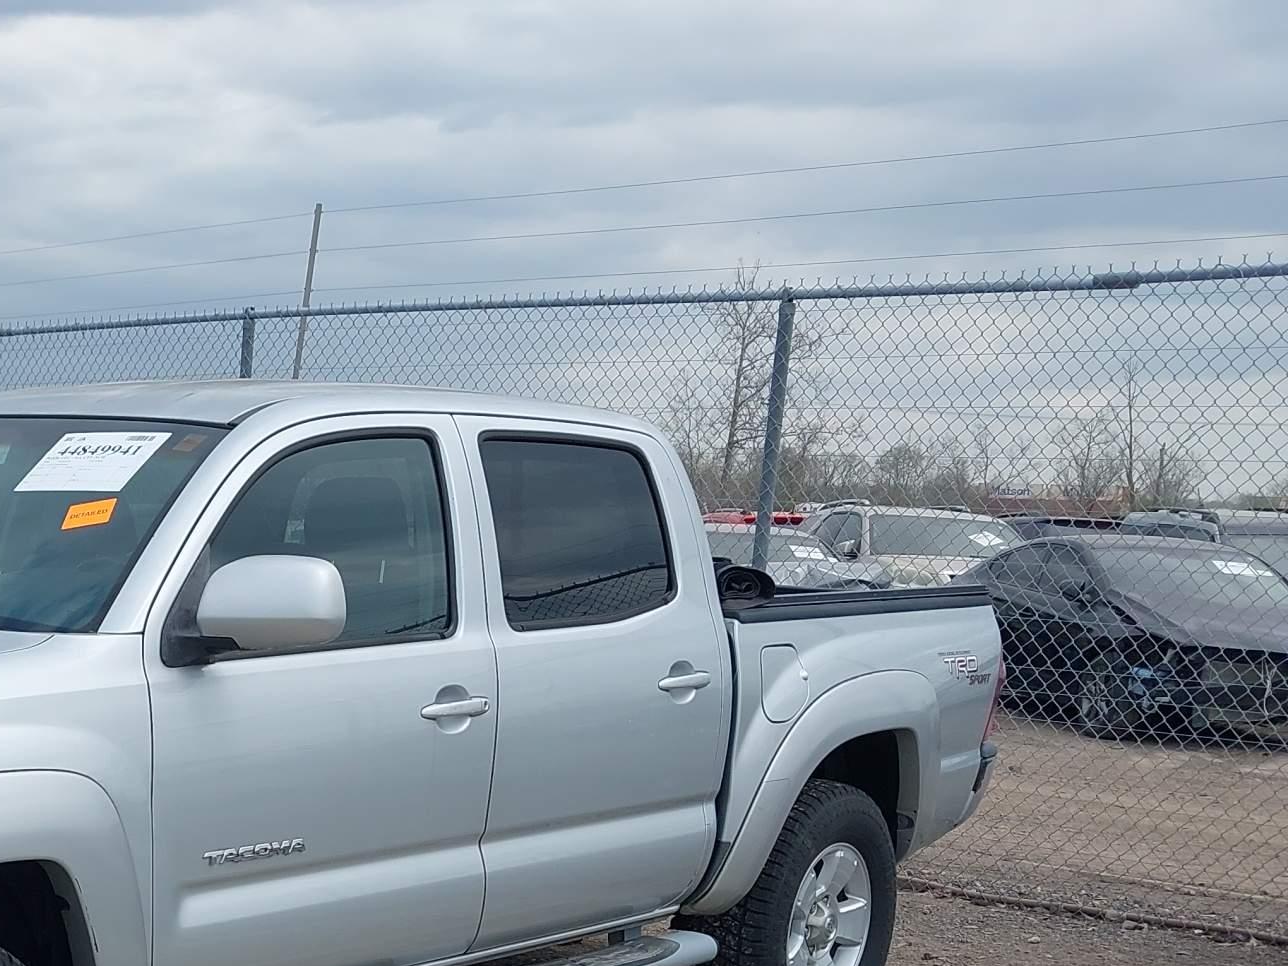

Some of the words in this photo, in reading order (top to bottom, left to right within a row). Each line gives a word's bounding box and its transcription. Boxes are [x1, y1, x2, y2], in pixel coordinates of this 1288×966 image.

[57, 445, 143, 456] 44849941
[943, 656, 978, 680] TRD
[202, 838, 305, 865] TACOMA
